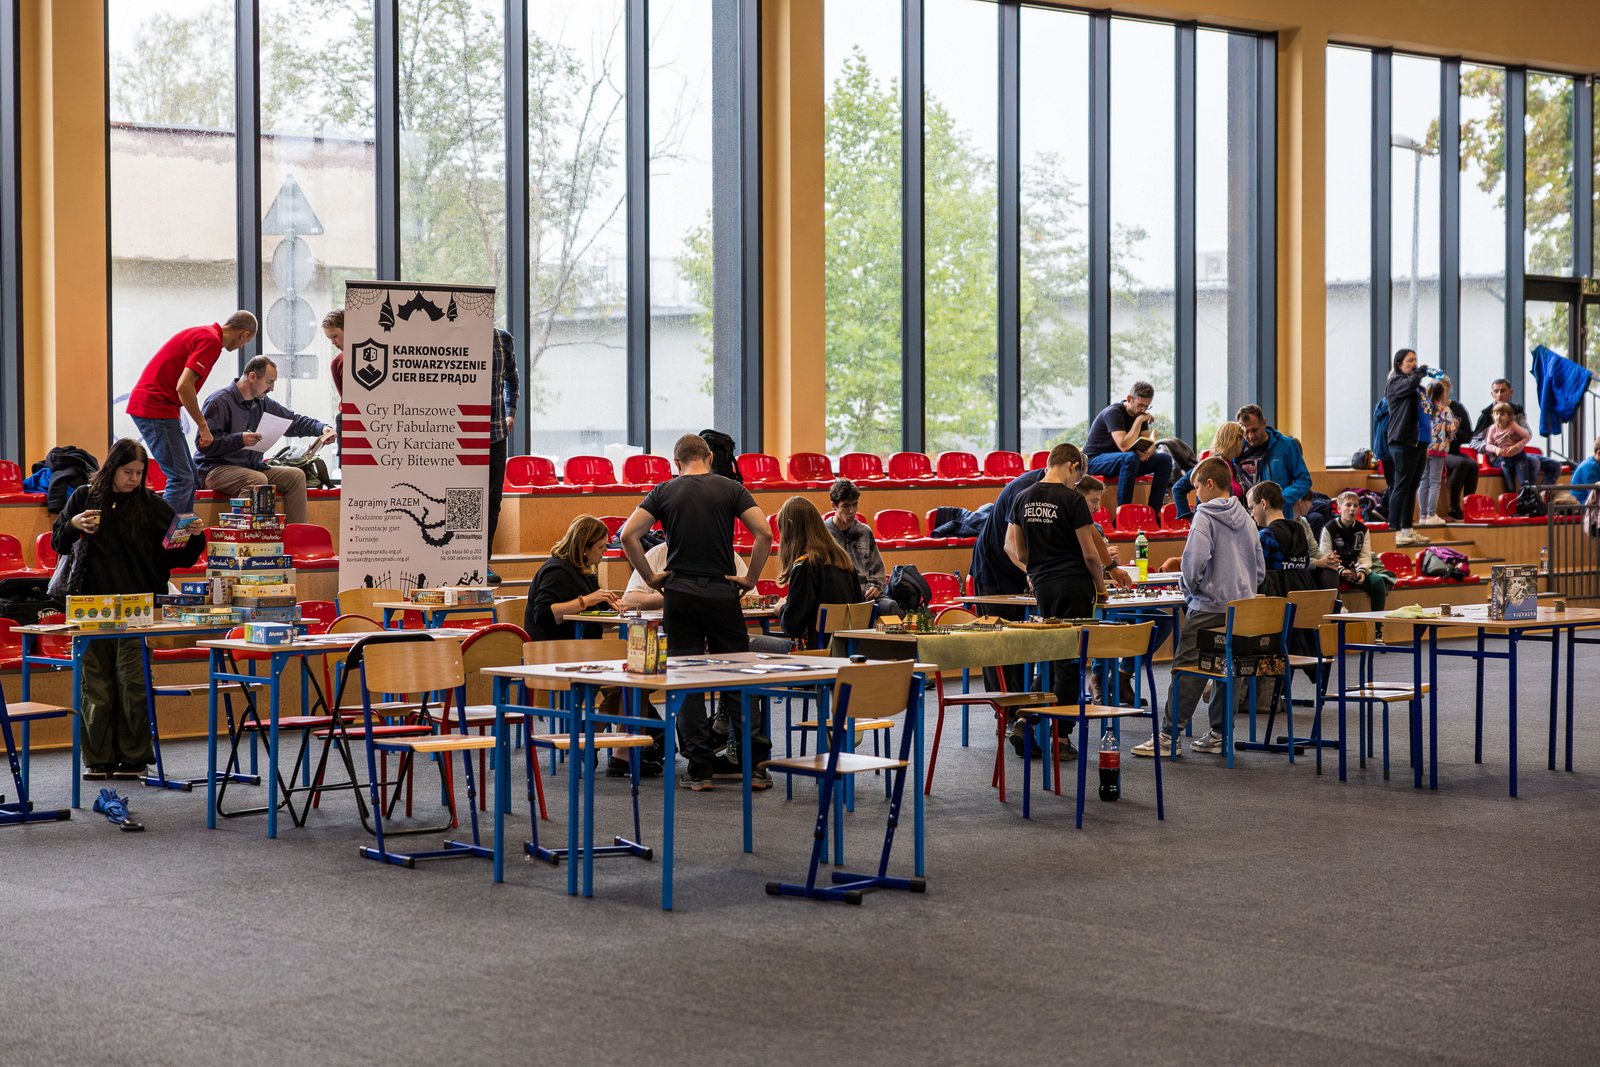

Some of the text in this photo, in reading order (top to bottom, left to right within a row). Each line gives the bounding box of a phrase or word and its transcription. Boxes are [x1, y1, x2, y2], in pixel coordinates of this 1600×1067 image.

[393, 345, 469, 356] KARKONOSKIE
[392, 359, 486, 370] STOWARZYSZENIE
[392, 372, 477, 385] GIER BEZ PRĄDU
[367, 403, 455, 419] Gry Planszowe
[370, 420, 455, 436] Gry Fabularne
[377, 437, 455, 453] Gry Karciane
[381, 454, 454, 470] Gry Bitewne
[348, 498, 420, 508] Zagrajmy RAZEM
[1024, 507, 1057, 518] JELONKA
